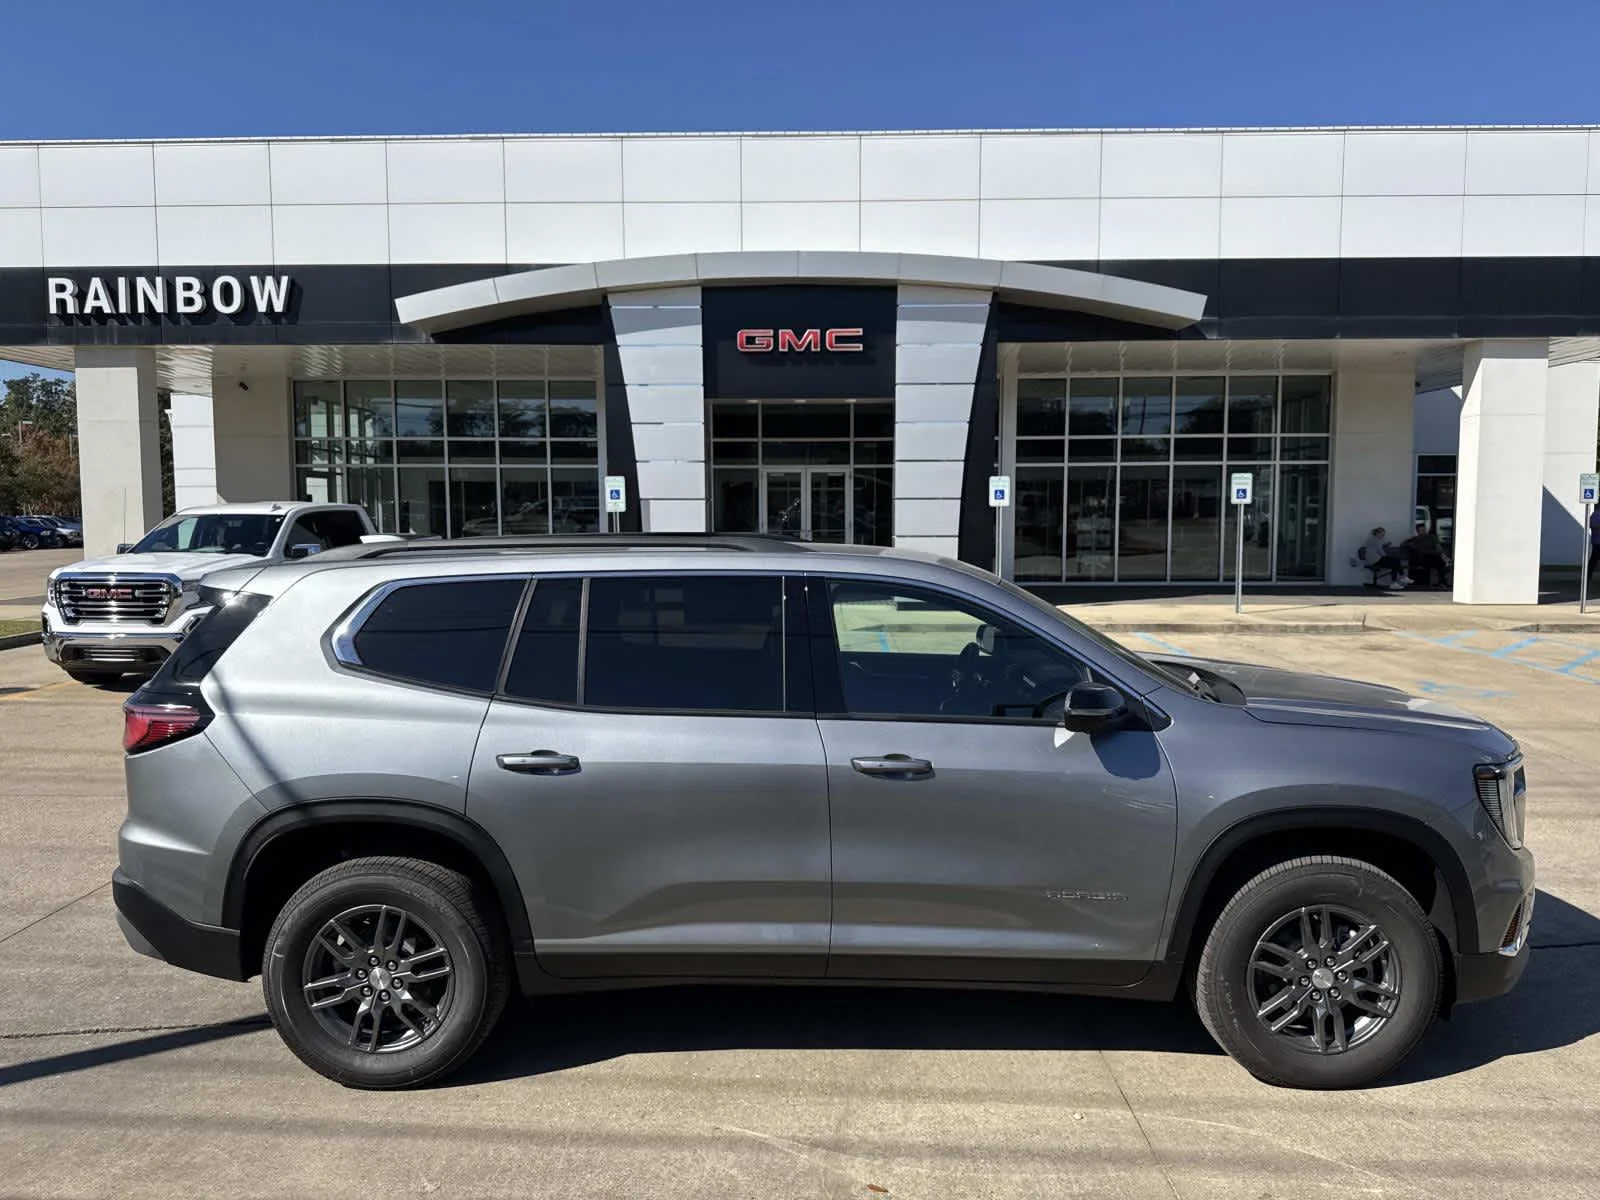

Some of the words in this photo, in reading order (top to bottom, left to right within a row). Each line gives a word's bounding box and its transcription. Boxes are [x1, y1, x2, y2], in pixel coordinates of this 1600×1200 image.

[47, 275, 290, 314] RAINBOW
[736, 328, 864, 352] GMC
[86, 588, 133, 599] GMC
